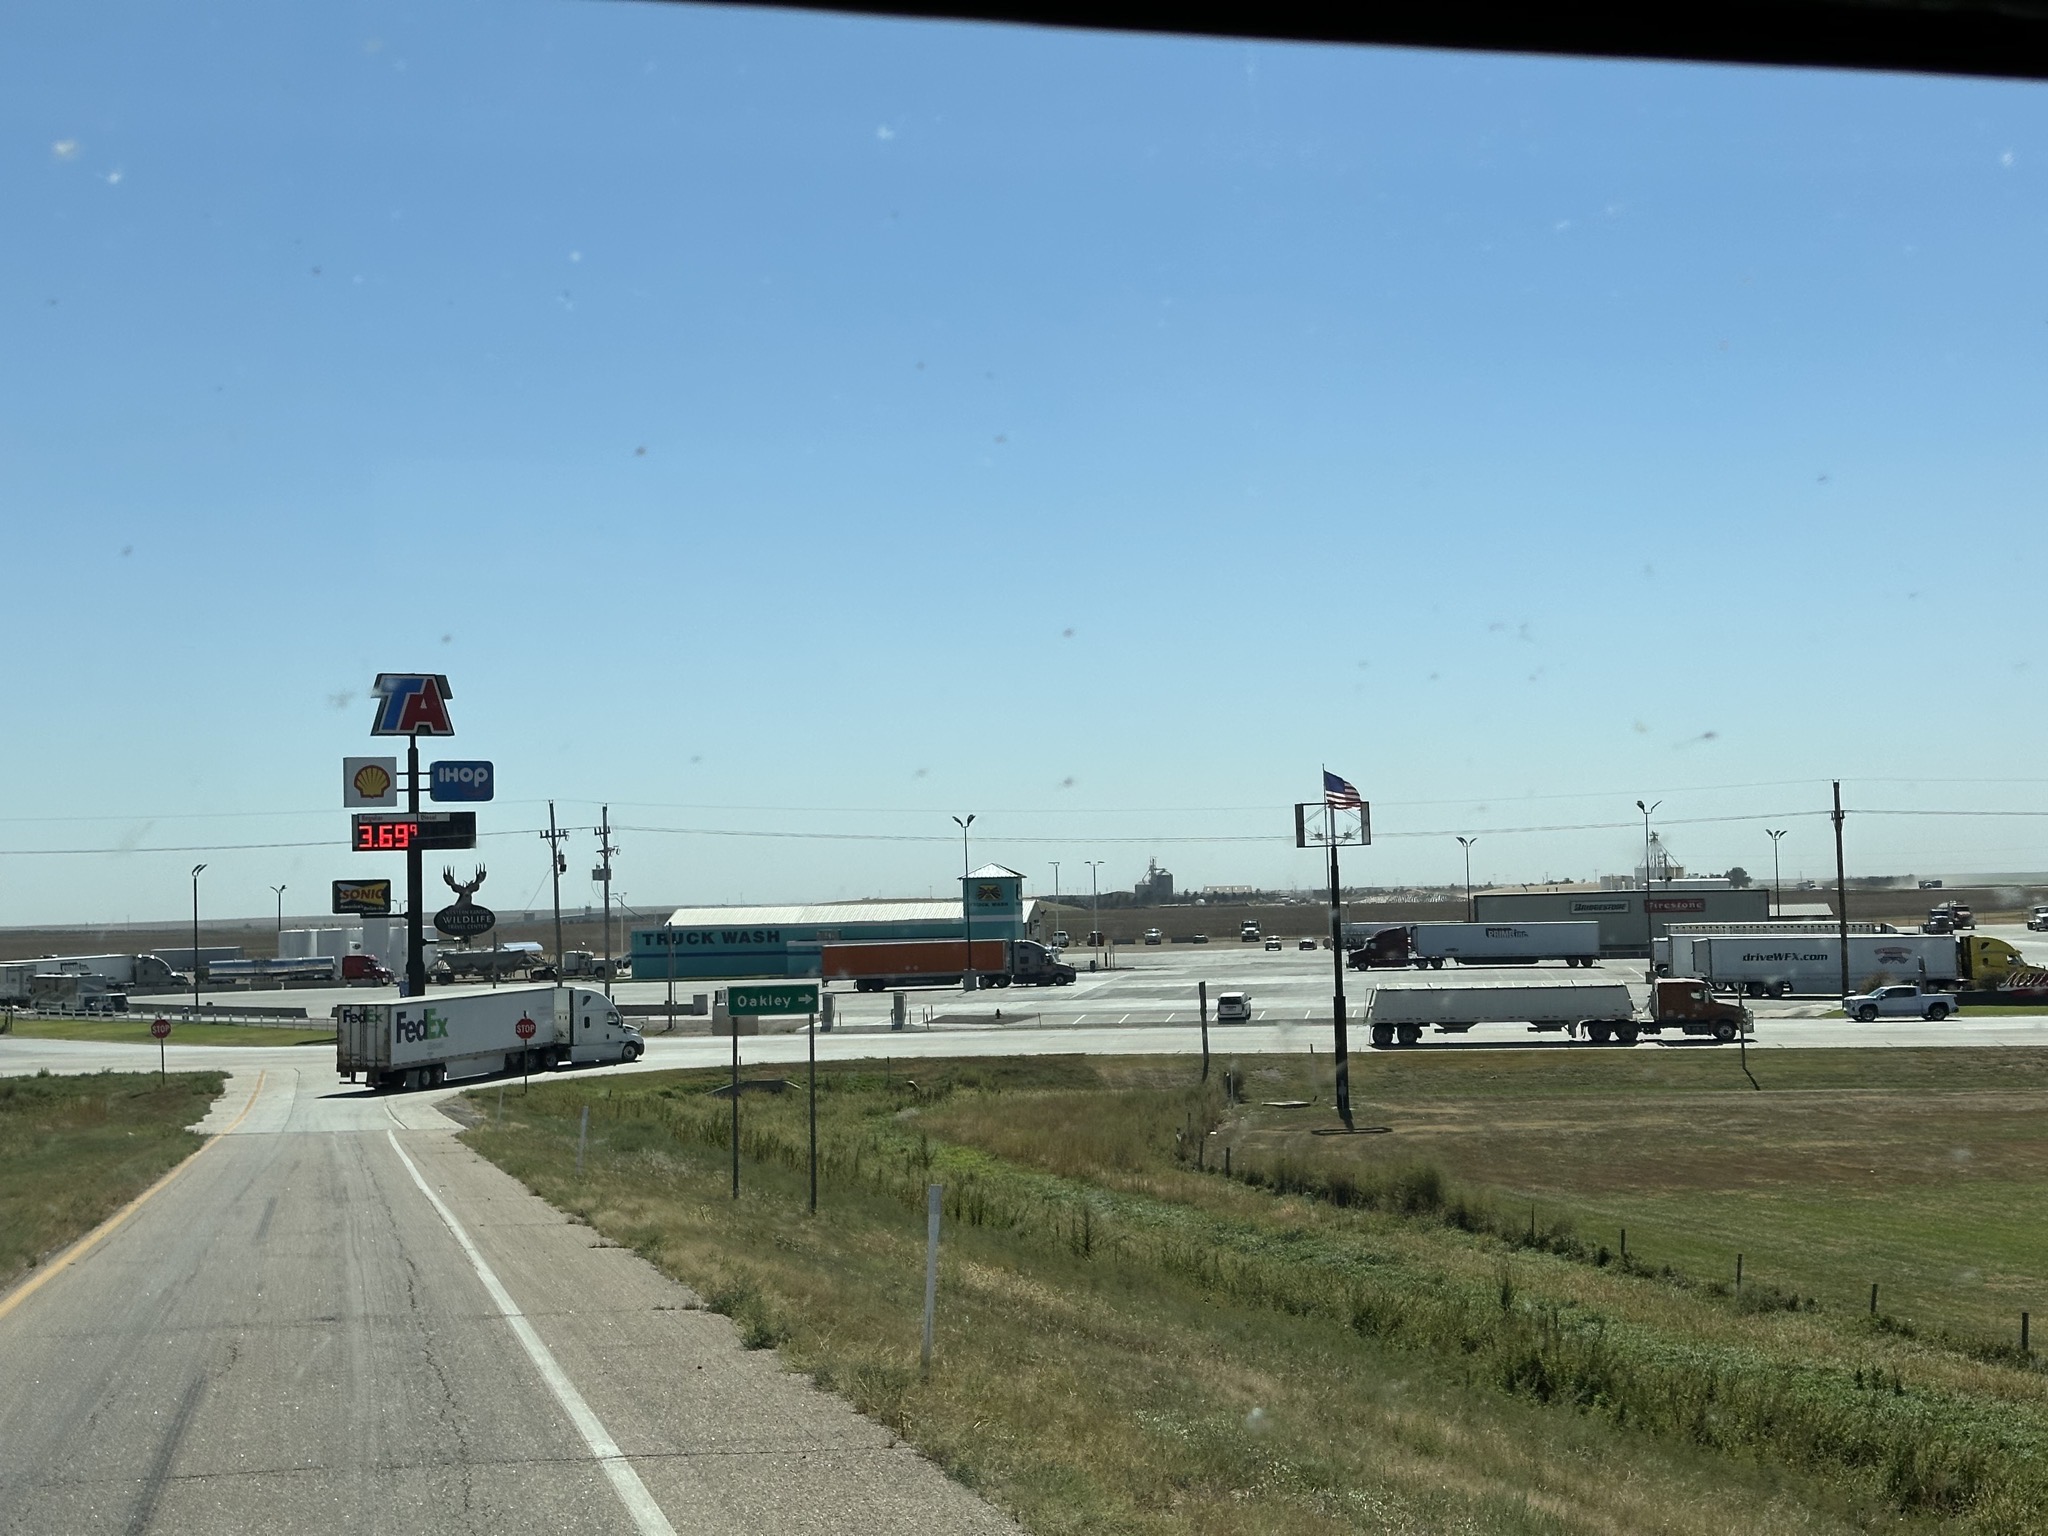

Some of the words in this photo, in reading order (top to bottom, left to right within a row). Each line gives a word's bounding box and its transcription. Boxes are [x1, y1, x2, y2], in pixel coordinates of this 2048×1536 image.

[371, 674, 454, 735] TA
[438, 767, 489, 788] IHOP
[341, 889, 384, 900] SONIC
[442, 915, 492, 924] WILDLIFE
[642, 931, 715, 946] TRUCK
[721, 930, 781, 944] WASH
[1486, 927, 1514, 938] PRIME
[1742, 952, 1829, 961] driveWFX.com
[737, 994, 791, 1008] Oakley
[343, 1008, 384, 1023] FedEx
[152, 1024, 170, 1034] STOP
[396, 1008, 449, 1044] FedEx
[516, 1023, 535, 1034] STOP
